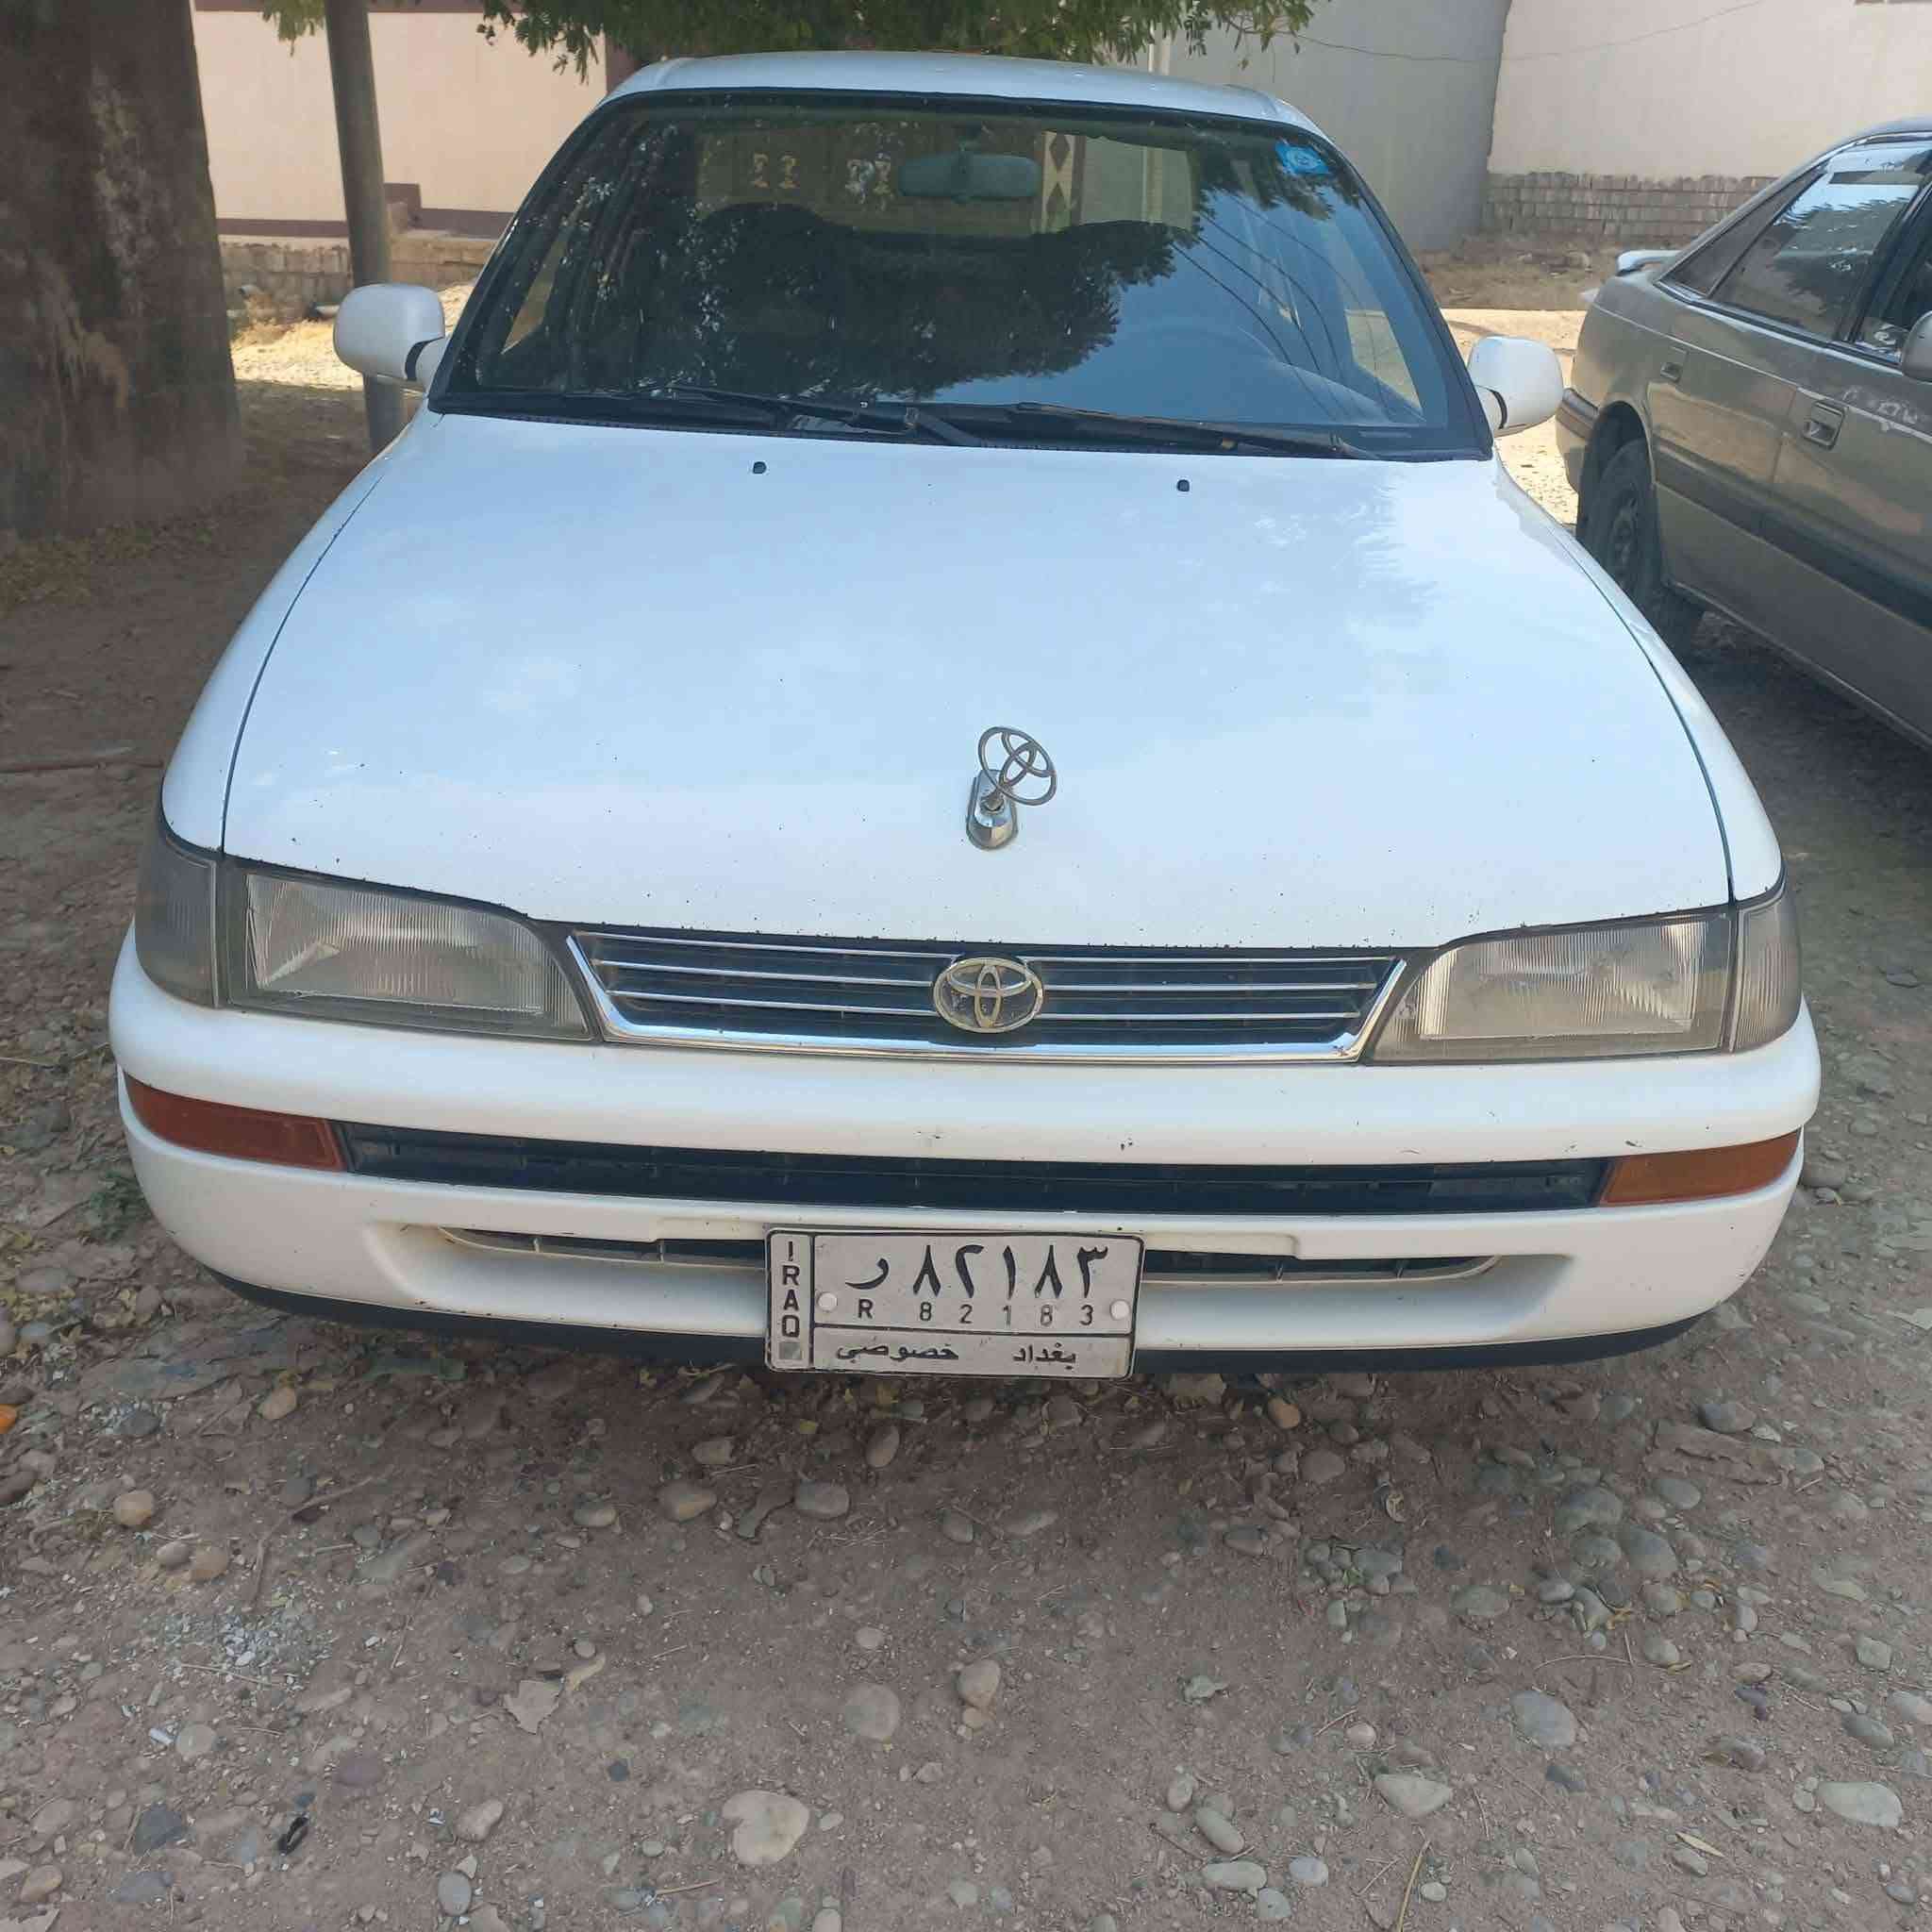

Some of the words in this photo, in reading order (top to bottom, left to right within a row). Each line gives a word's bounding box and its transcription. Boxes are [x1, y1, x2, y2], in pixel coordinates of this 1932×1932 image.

[781, 1241, 801, 1338] IRAQ
[844, 1257, 890, 1290] ر
[912, 1244, 1109, 1300] ٨٢١٨٣
[858, 1298, 874, 1320] R
[919, 1301, 1094, 1326] 82183
[1012, 1342, 1077, 1370] بغداد
